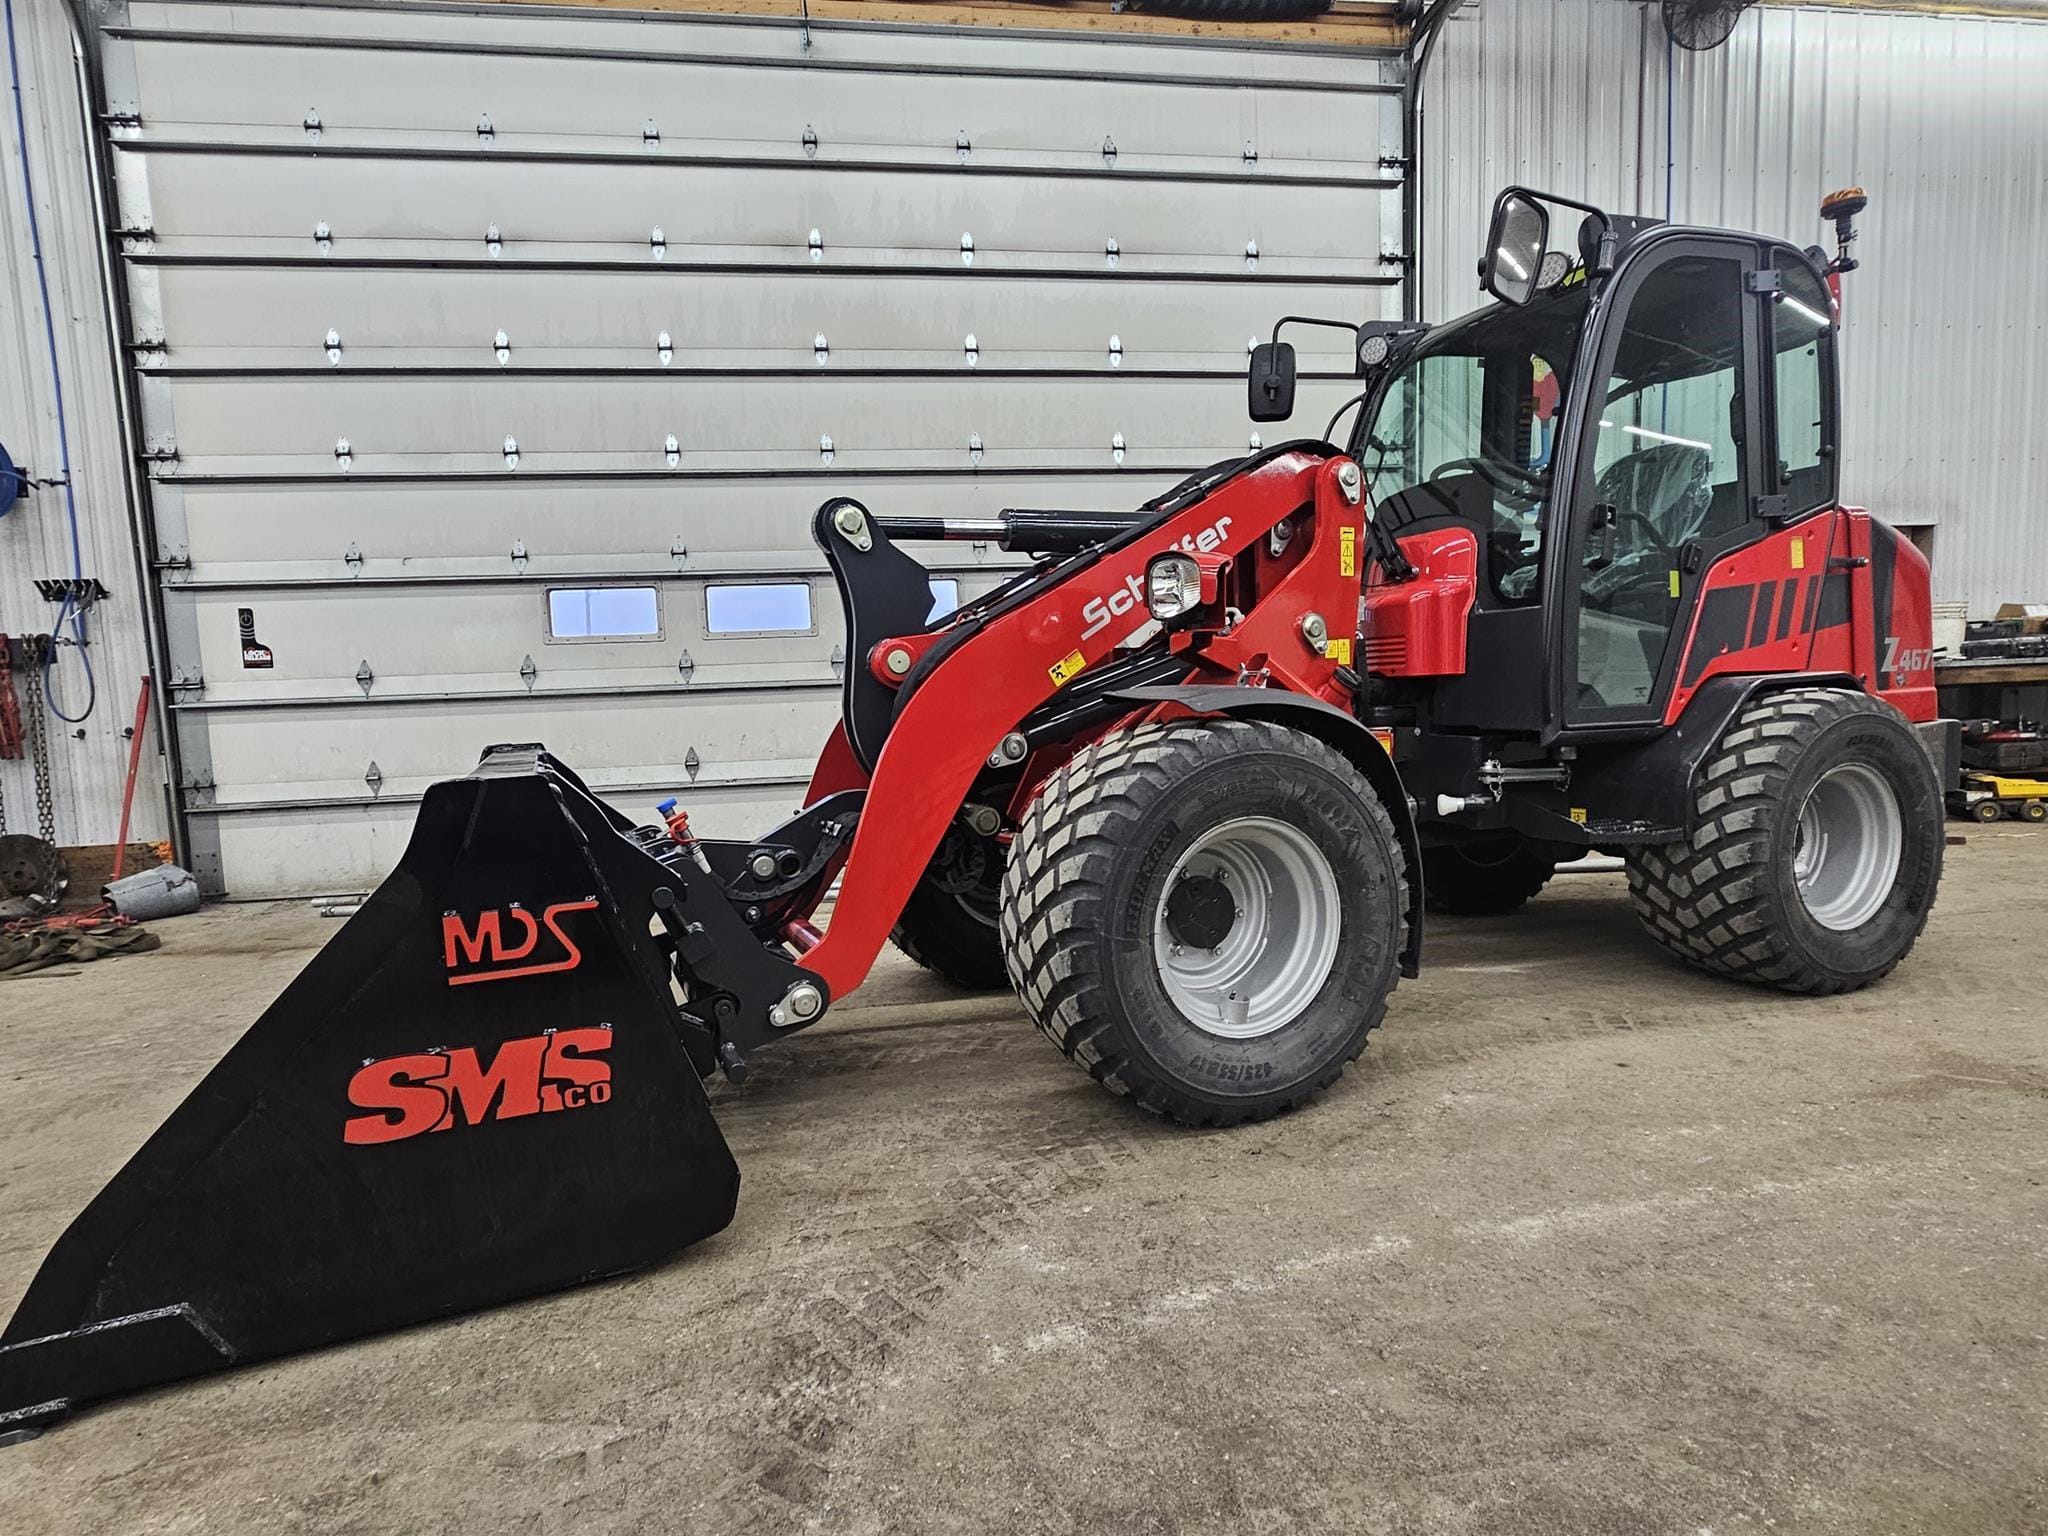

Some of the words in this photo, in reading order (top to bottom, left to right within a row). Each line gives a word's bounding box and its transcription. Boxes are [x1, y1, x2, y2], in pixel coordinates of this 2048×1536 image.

[1081, 516, 1233, 641] Schfer
[443, 900, 599, 986] MDS
[343, 1028, 613, 1145] SMS
